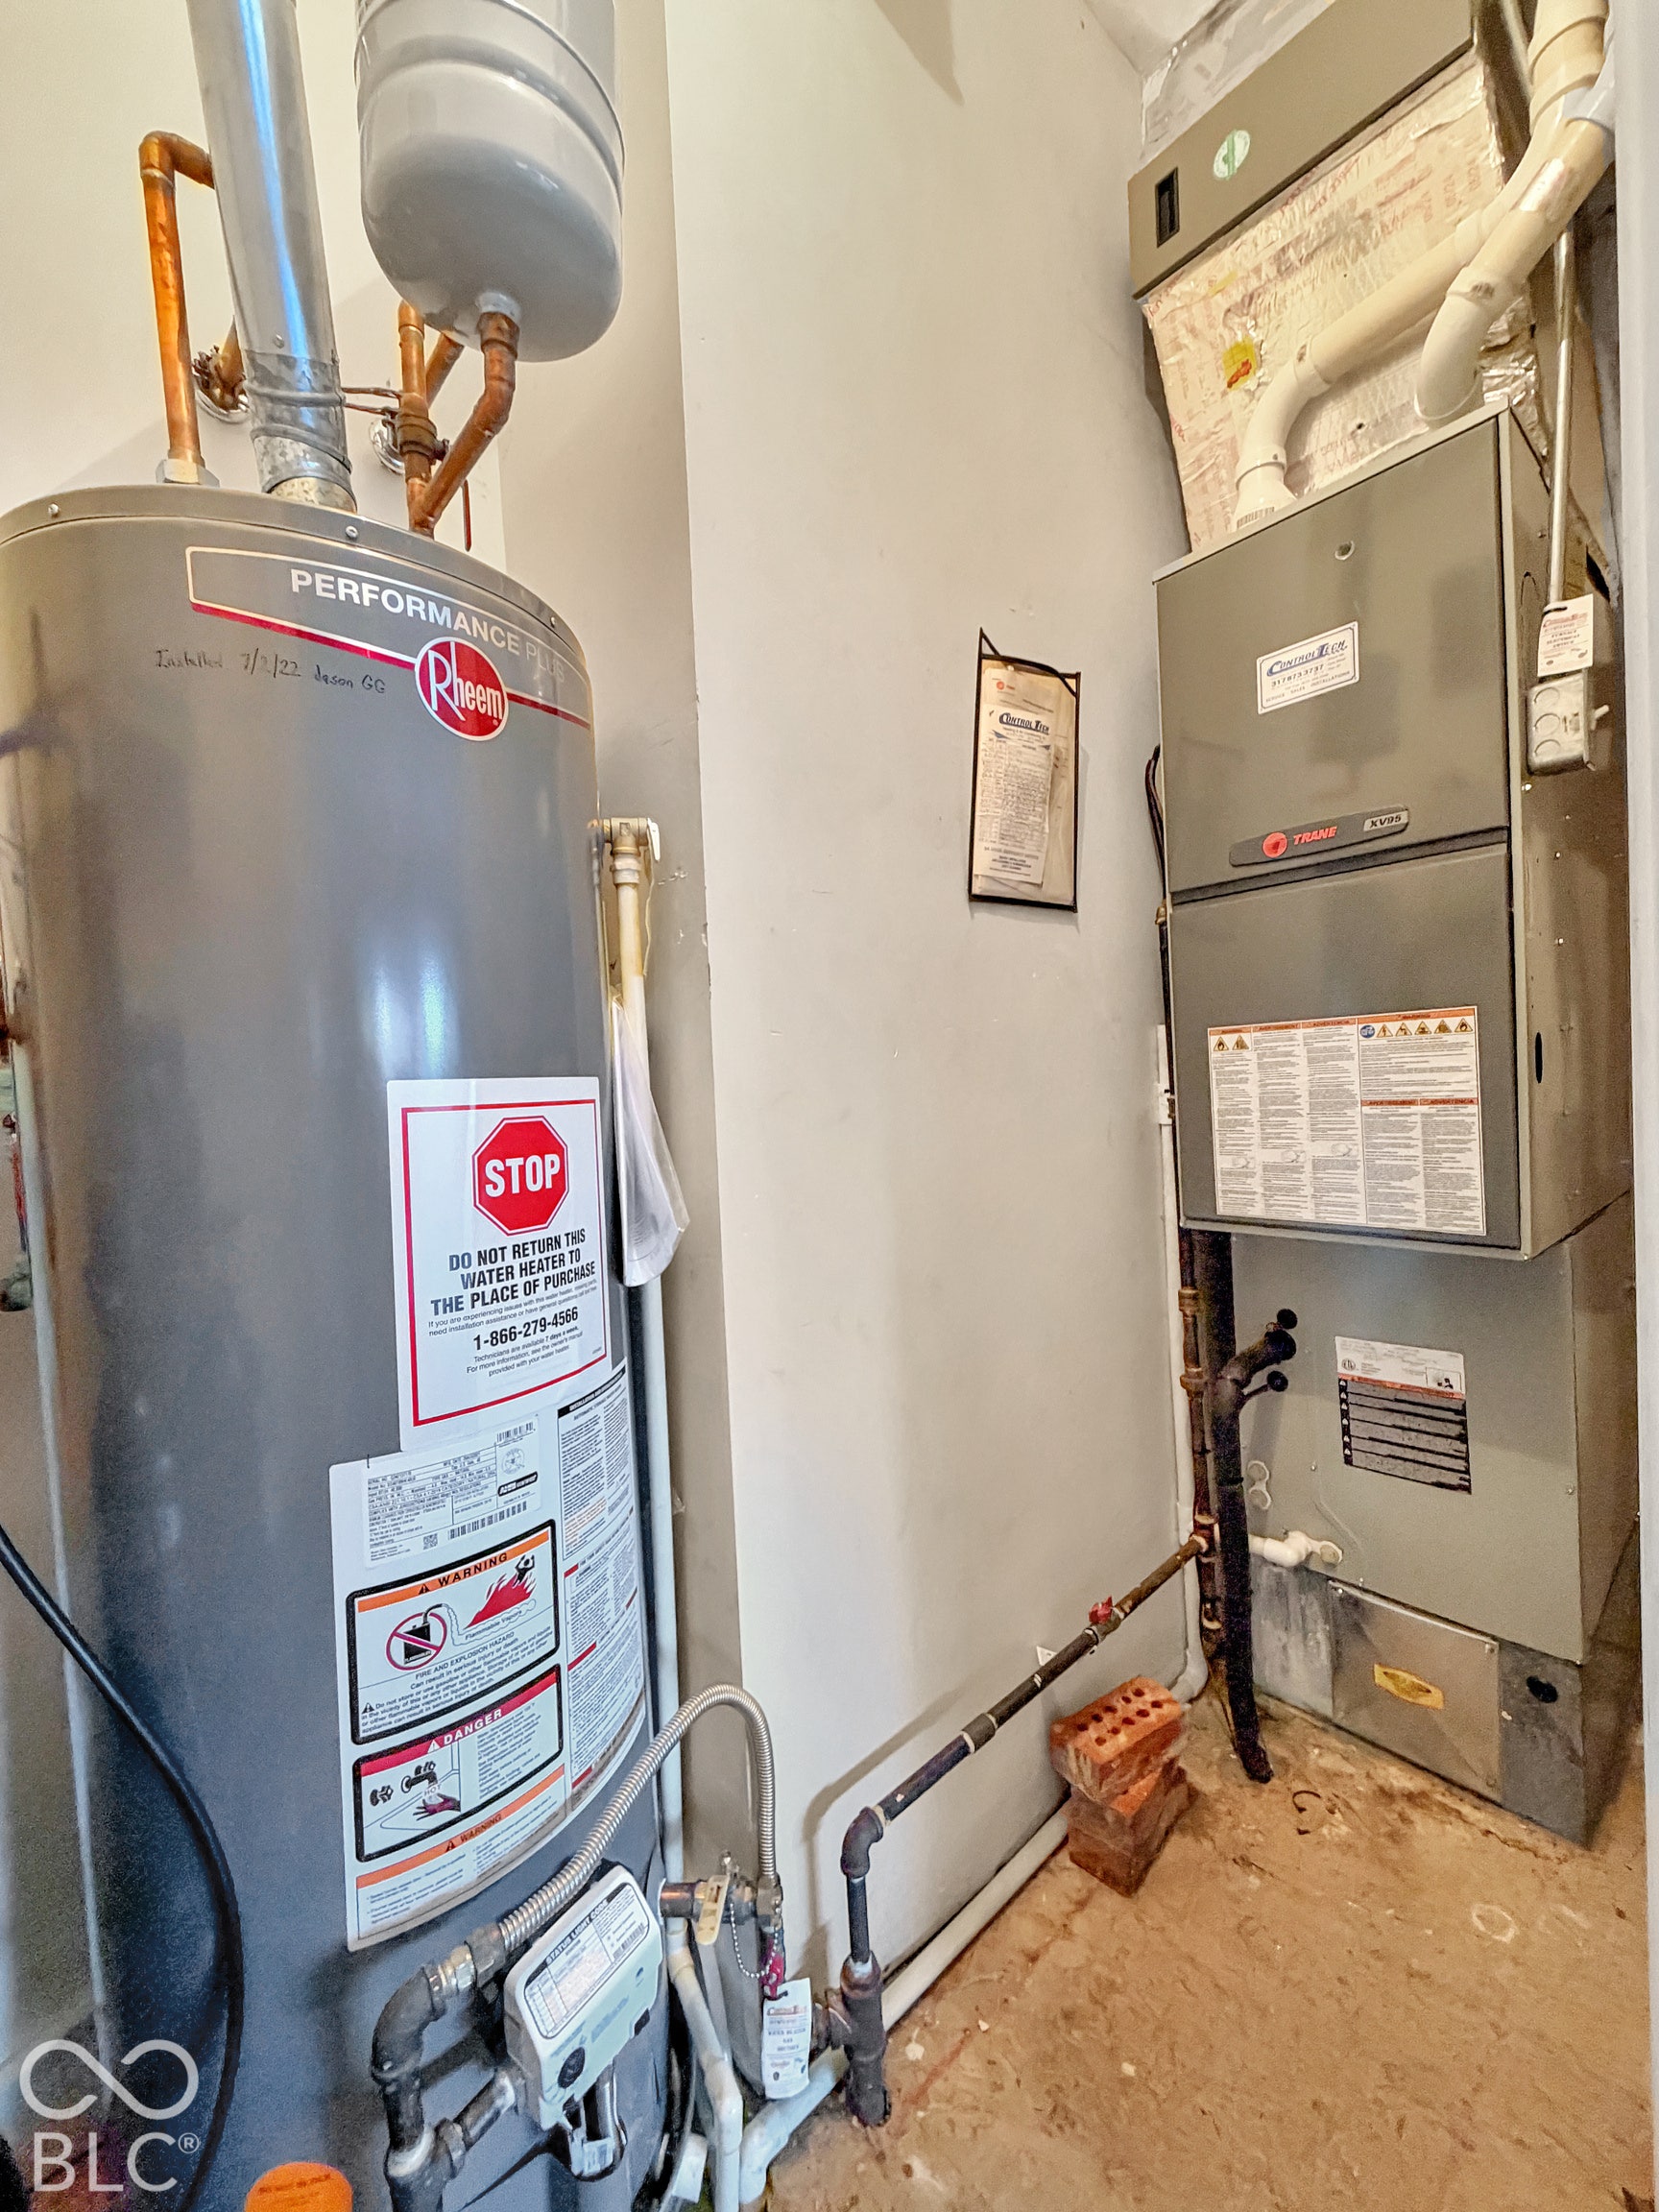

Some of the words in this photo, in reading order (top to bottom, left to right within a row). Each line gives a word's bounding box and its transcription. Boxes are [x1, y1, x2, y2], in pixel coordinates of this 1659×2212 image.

[292, 568, 519, 656] PERFORMANCE
[525, 637, 565, 684] PLUS
[427, 640, 504, 722] Rheem
[1293, 826, 1337, 845] TRANE
[1369, 815, 1402, 829] XV95
[484, 1152, 561, 1198] STOP
[448, 1252, 472, 1272] DO
[477, 1245, 508, 1266] NOT
[512, 1235, 562, 1261] RETURN
[564, 1228, 586, 1247] THIS
[460, 1264, 515, 1290] WATER
[519, 1252, 565, 1278] HEATER
[568, 1248, 581, 1264] TO
[430, 1295, 465, 1316] THE
[470, 1284, 518, 1310] PLACE
[523, 1279, 541, 1296] OF
[544, 1261, 596, 1291] PURCHASE
[428, 1328, 447, 1336] need
[448, 1320, 484, 1333] installation
[485, 1312, 517, 1325] assistance
[435, 1320, 448, 1329] you
[449, 1316, 462, 1325] are
[463, 1308, 503, 1321] experiencing
[473, 1306, 579, 1351] 1-866-279-4566
[467, 1364, 479, 1374] For
[479, 1361, 496, 1370] more
[474, 1349, 510, 1363] Technicians
[489, 1364, 516, 1377] provided
[438, 1552, 509, 1587] WARNING
[465, 1621, 500, 1640] Flammable
[500, 1610, 522, 1623] Vapors
[410, 1681, 423, 1690] Can
[425, 1672, 445, 1684] result
[478, 1650, 494, 1662] injury
[416, 1669, 432, 1680] FIRE
[434, 1662, 448, 1672] AND
[450, 1645, 488, 1666] EXPLOSION
[489, 1631, 515, 1647] HAZARD
[444, 1708, 503, 1746] DANGER
[461, 1814, 502, 1842] WARNING
[545, 1936, 573, 1964] STATUS
[571, 1918, 591, 1938] LIGHT
[590, 1899, 609, 1919] CODE
